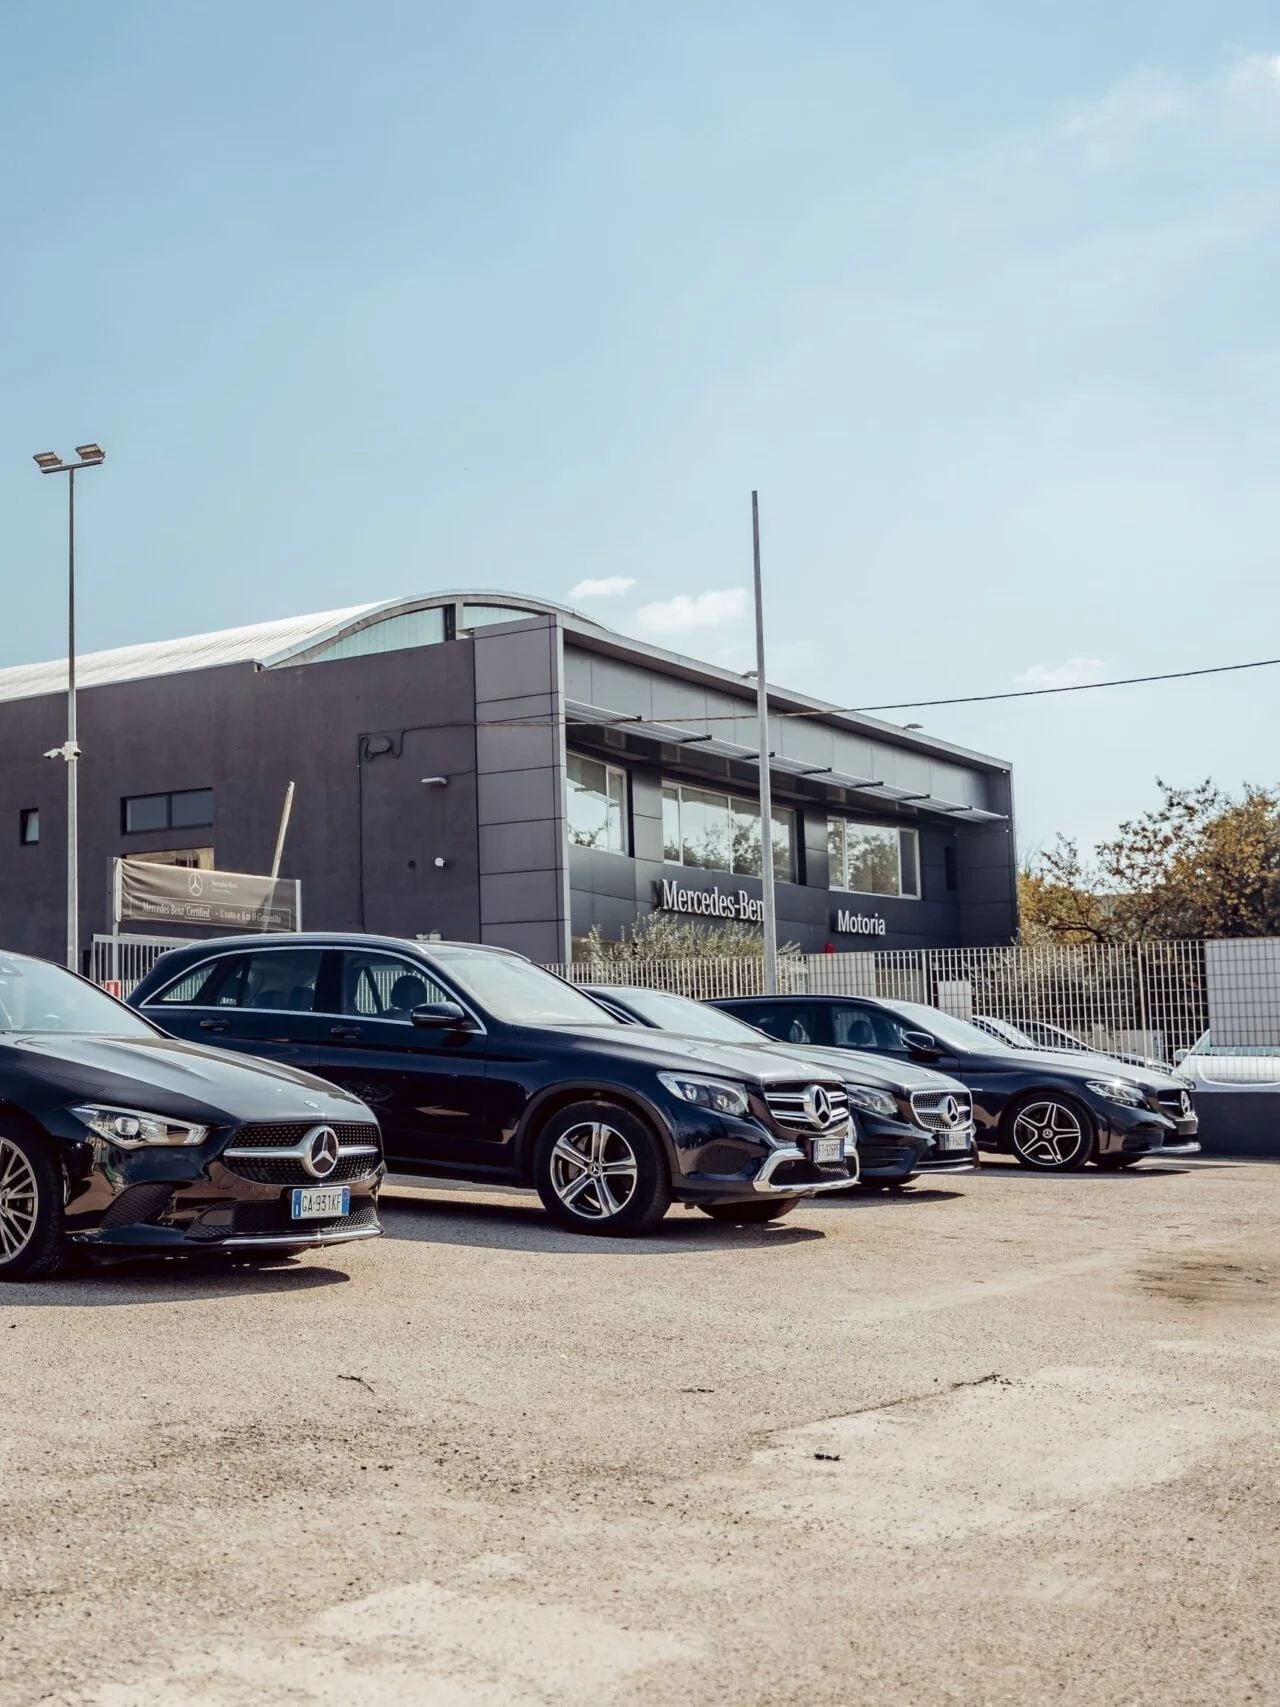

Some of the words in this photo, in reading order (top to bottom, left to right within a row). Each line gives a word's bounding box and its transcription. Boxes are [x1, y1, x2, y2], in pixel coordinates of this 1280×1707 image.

[186, 906, 210, 918] Certified
[662, 879, 764, 922] Mercedes-Ben
[837, 909, 886, 936] Motoria
